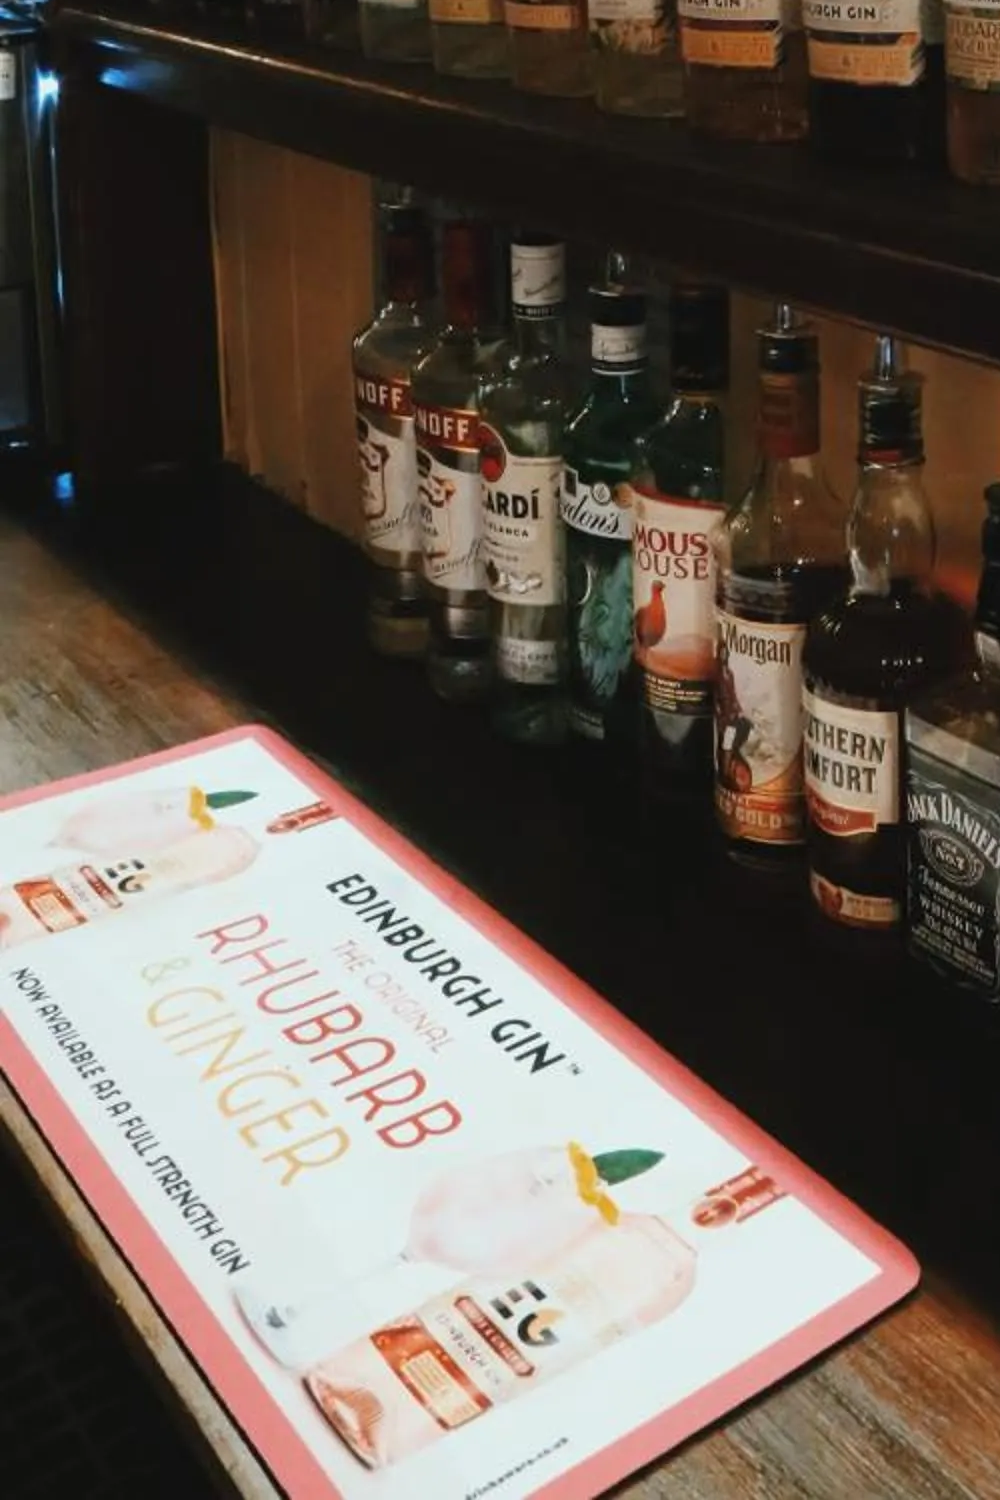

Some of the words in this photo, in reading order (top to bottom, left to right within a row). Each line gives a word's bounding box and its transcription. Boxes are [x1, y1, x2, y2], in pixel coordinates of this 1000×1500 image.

[847, 5, 876, 20] GIN
[416, 407, 469, 443] NOFF
[735, 807, 782, 829] GOLD
[194, 912, 463, 1150] RHUBARB
[326, 872, 504, 1018] EDINBURGH
[489, 1018, 566, 1075] GIN
[333, 937, 377, 976] THE
[364, 970, 456, 1055] ORIGINAL
[11, 966, 51, 1002] NOW
[36, 1002, 105, 1080] AVAILABLE
[90, 1079, 121, 1102] AS
[106, 1100, 130, 1118] A
[119, 1114, 160, 1158] FULL
[146, 1154, 224, 1241] STRENGTH
[209, 1238, 251, 1276] GIN
[146, 985, 351, 1188] GINGER
